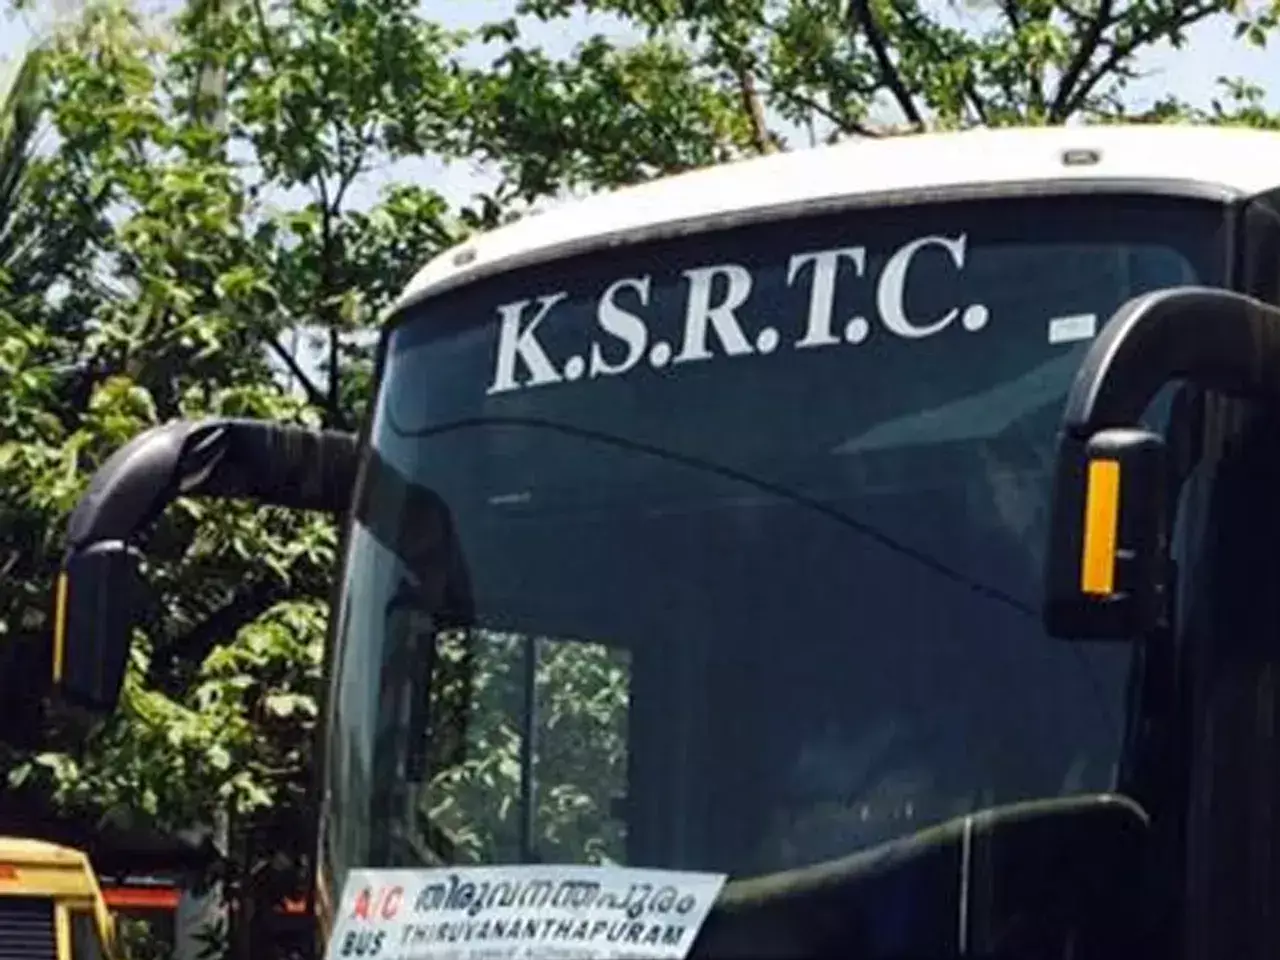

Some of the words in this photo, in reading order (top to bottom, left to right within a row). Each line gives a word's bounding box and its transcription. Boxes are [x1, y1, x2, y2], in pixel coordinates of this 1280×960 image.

[486, 233, 989, 395] K.S.R.T.C.
[350, 884, 403, 922] A/C
[340, 929, 388, 958] BUS
[401, 916, 686, 946] THIRUVANANTHAPURAM
